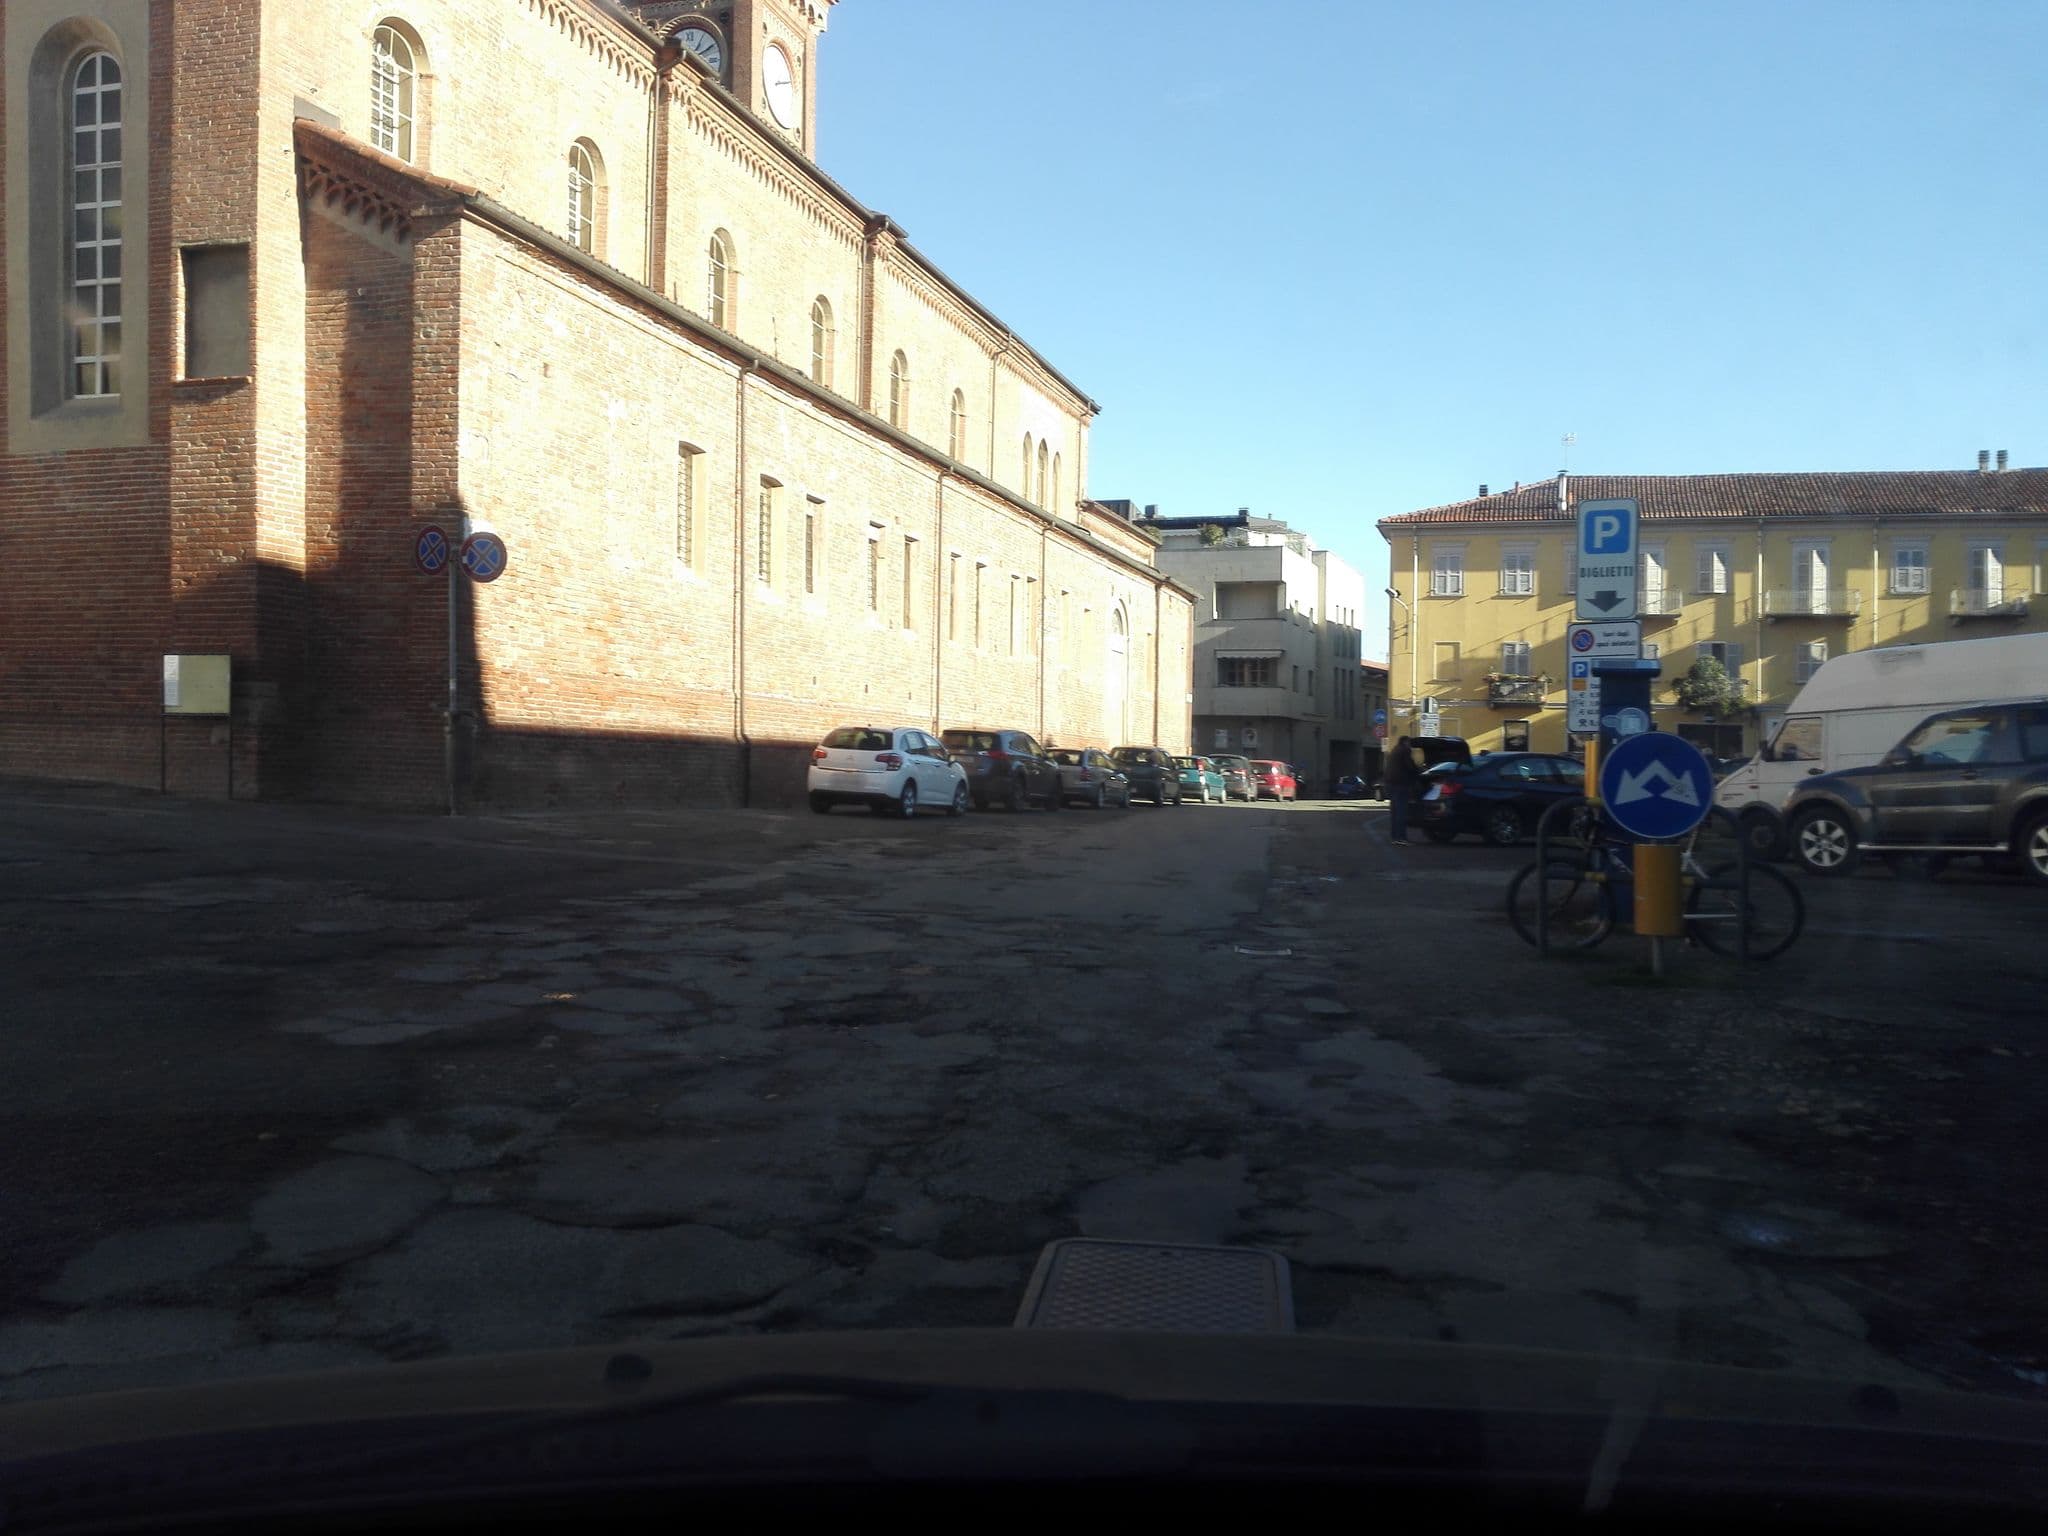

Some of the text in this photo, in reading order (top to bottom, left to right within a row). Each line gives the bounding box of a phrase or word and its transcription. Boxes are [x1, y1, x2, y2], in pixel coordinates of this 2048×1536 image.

[1593, 515, 1620, 549] P
[1580, 566, 1634, 578] BIGLIETTI
[1575, 663, 1586, 676] P
